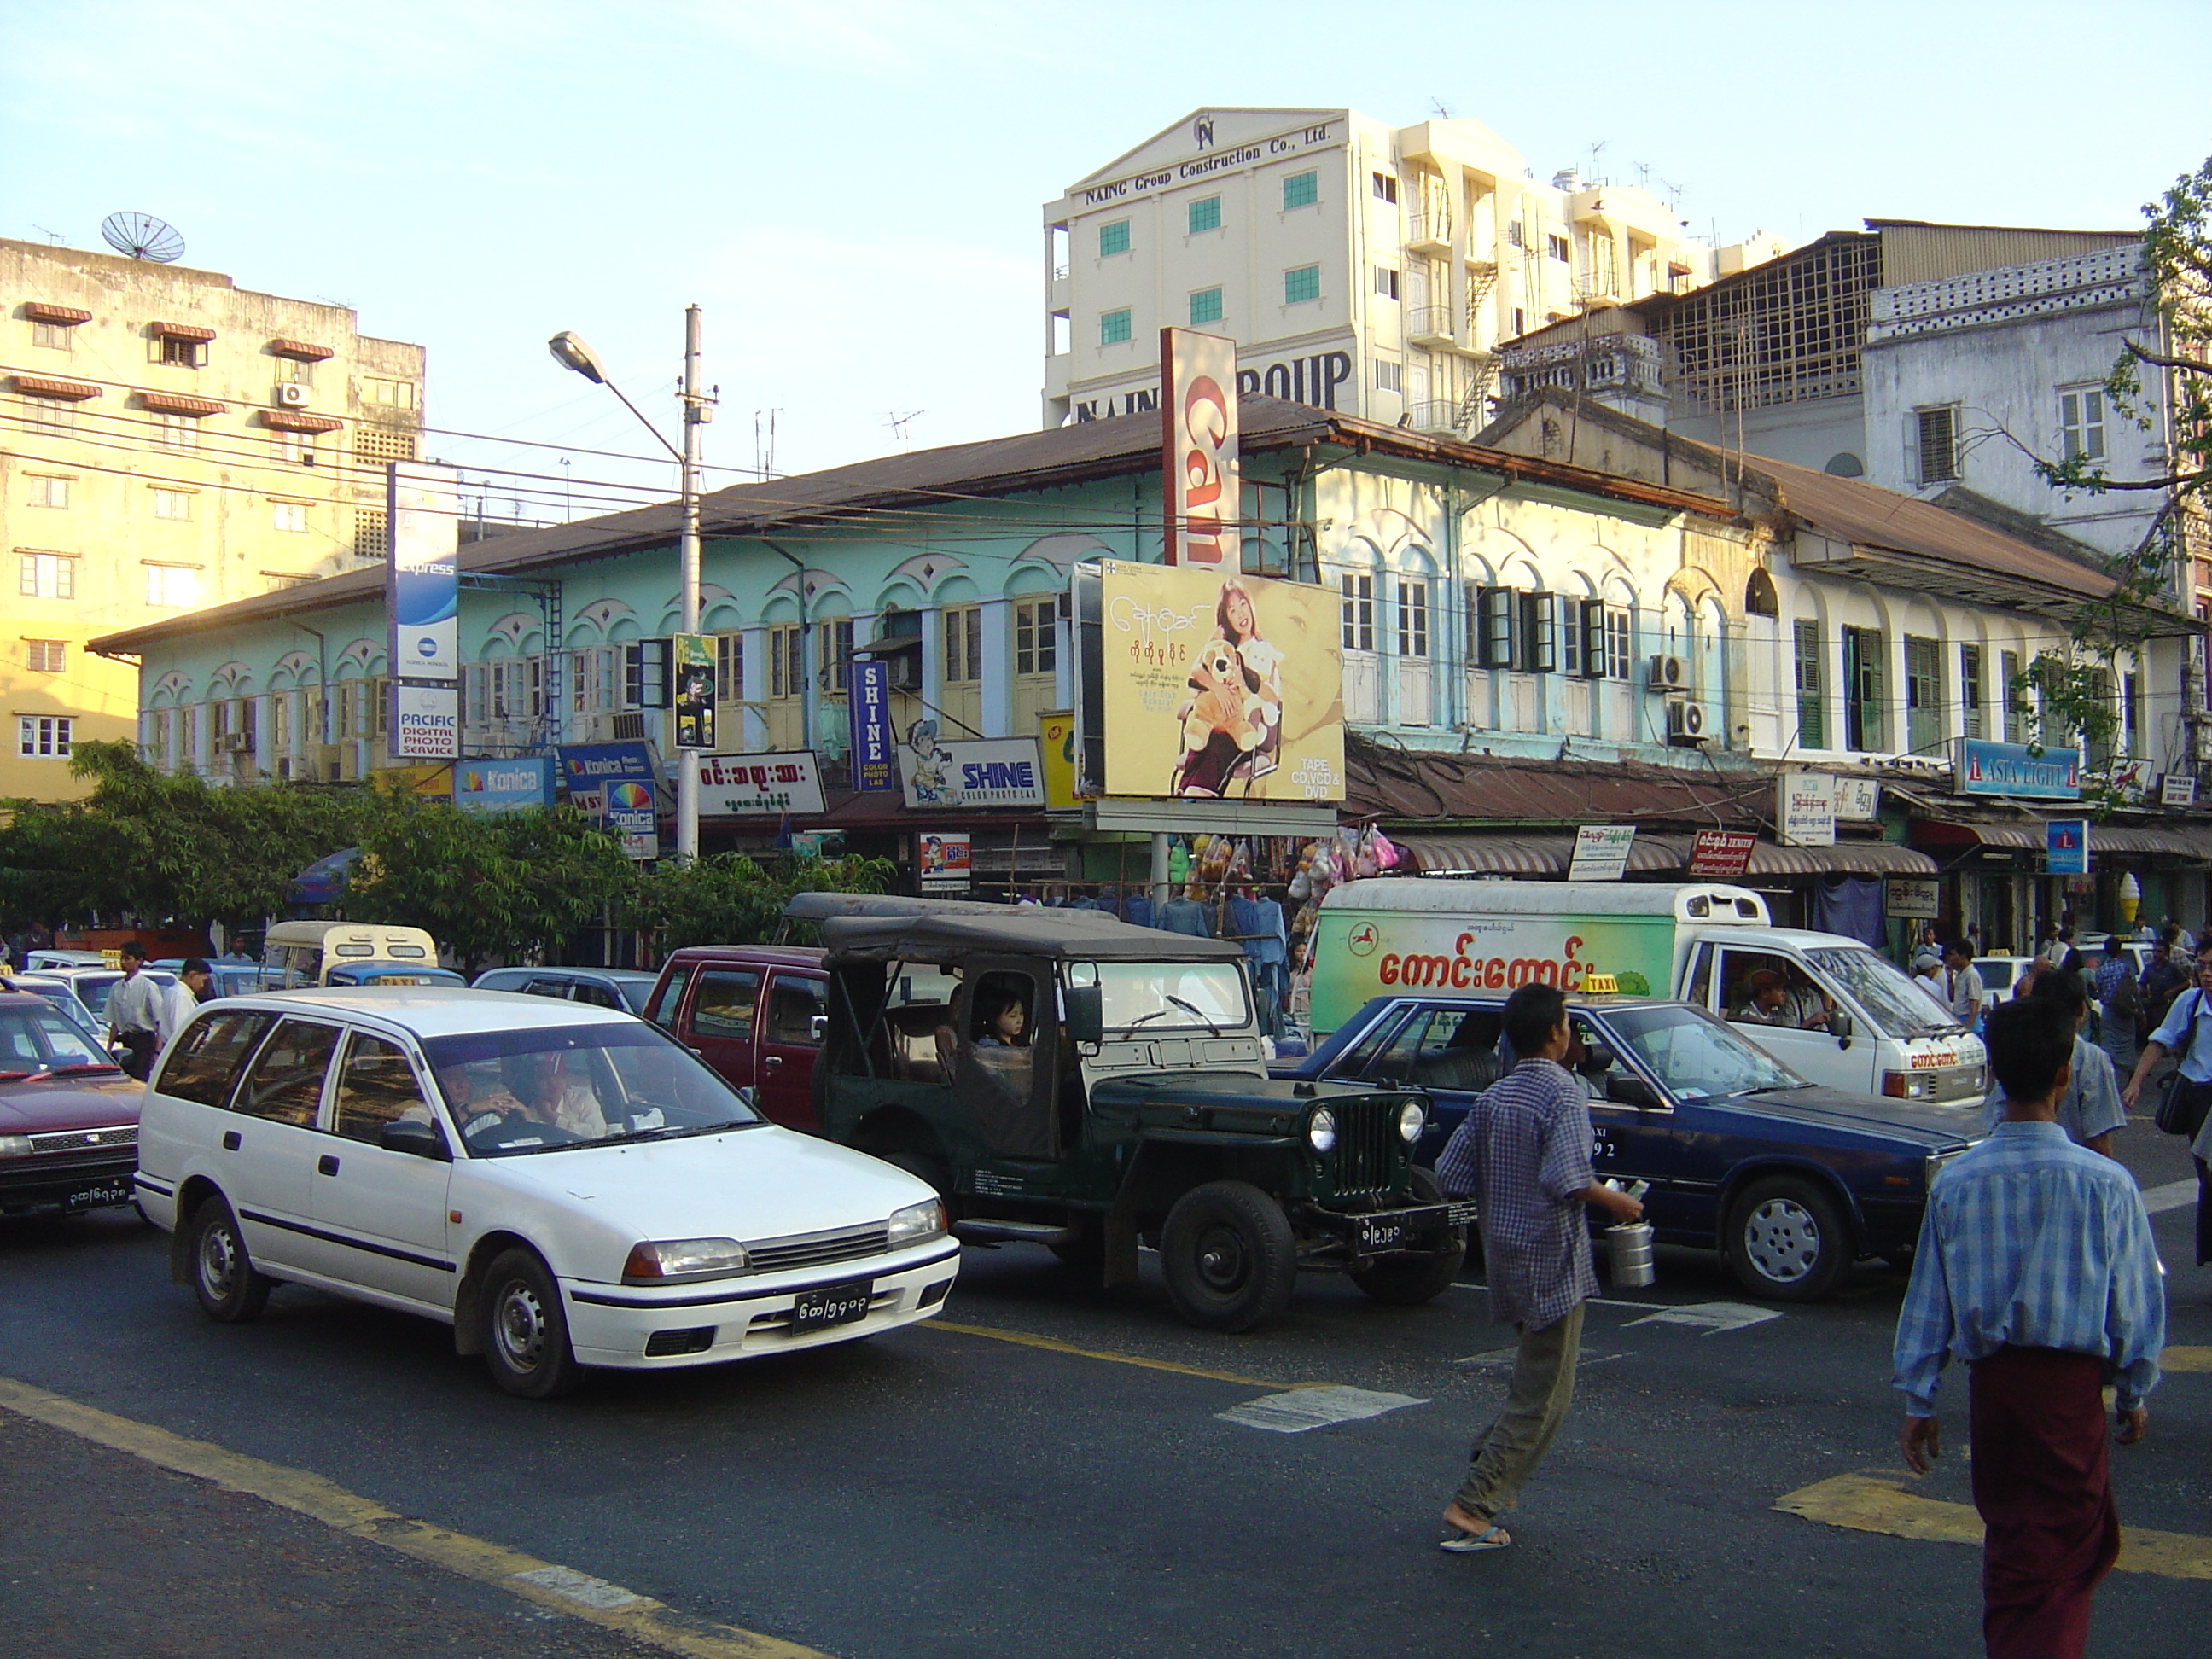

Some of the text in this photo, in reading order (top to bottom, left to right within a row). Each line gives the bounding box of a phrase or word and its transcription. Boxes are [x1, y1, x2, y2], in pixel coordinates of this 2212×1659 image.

[1086, 125, 1330, 205] NAING Group Construction Co., Ltd.
[1185, 375, 1227, 571] Can
[401, 713, 455, 727] PACIFIC
[865, 667, 882, 760] SHINE
[403, 727, 454, 736] DIGITAL
[405, 736, 452, 745] PHOTO
[404, 746, 454, 754] SERVICE
[585, 757, 622, 775] Konica
[1987, 759, 2063, 786] ASIA LIGHT
[487, 768, 537, 792] Konica
[961, 760, 1034, 789] SHINE
[868, 778, 884, 787] LAB
[961, 789, 1036, 800] COLOR PHOTO LAB
[1305, 785, 1328, 799] DVD
[610, 810, 653, 825] Konica
[1728, 838, 1754, 848] ZENITH
[1590, 978, 1616, 991] TAXI
